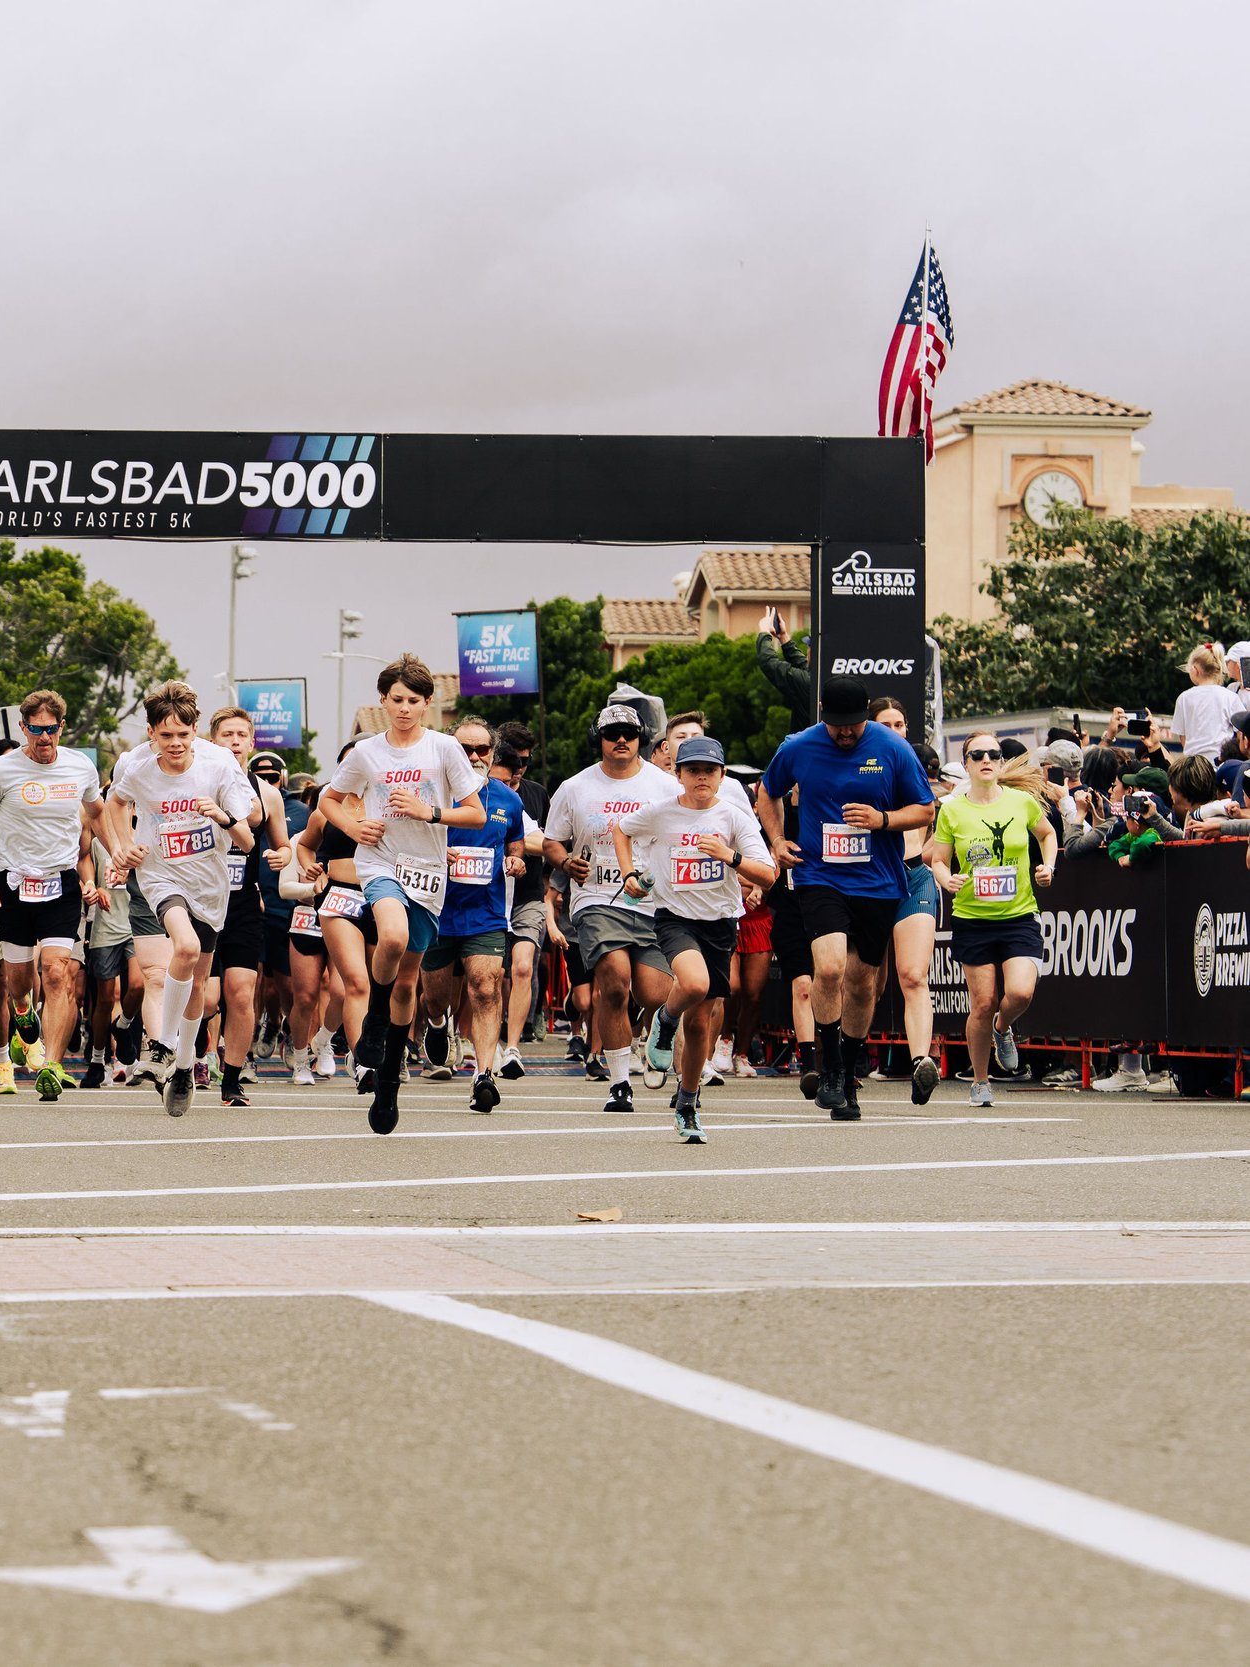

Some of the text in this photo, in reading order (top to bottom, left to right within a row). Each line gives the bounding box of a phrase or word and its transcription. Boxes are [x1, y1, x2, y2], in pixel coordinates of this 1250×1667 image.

[75, 511, 157, 528] FASTEST
[169, 511, 192, 529] 5K
[831, 572, 916, 587] CARLSBAD
[853, 586, 915, 595] CALIFORNIA
[480, 624, 514, 648] 5K
[502, 647, 530, 662] PACE
[831, 658, 915, 675] BROOKS
[256, 692, 285, 710] 5K
[270, 711, 293, 723] PACE
[385, 769, 421, 784] 5000
[170, 829, 213, 855] 5785
[830, 837, 867, 854] 6881
[457, 859, 492, 876] 6882
[678, 860, 722, 880] 7865
[24, 881, 60, 896] 5972
[402, 868, 441, 894] 5316
[980, 877, 1015, 895] 6670
[328, 895, 361, 917] 6821
[1216, 912, 1249, 946] PIZZA
[1040, 908, 1136, 977] BROOKS
